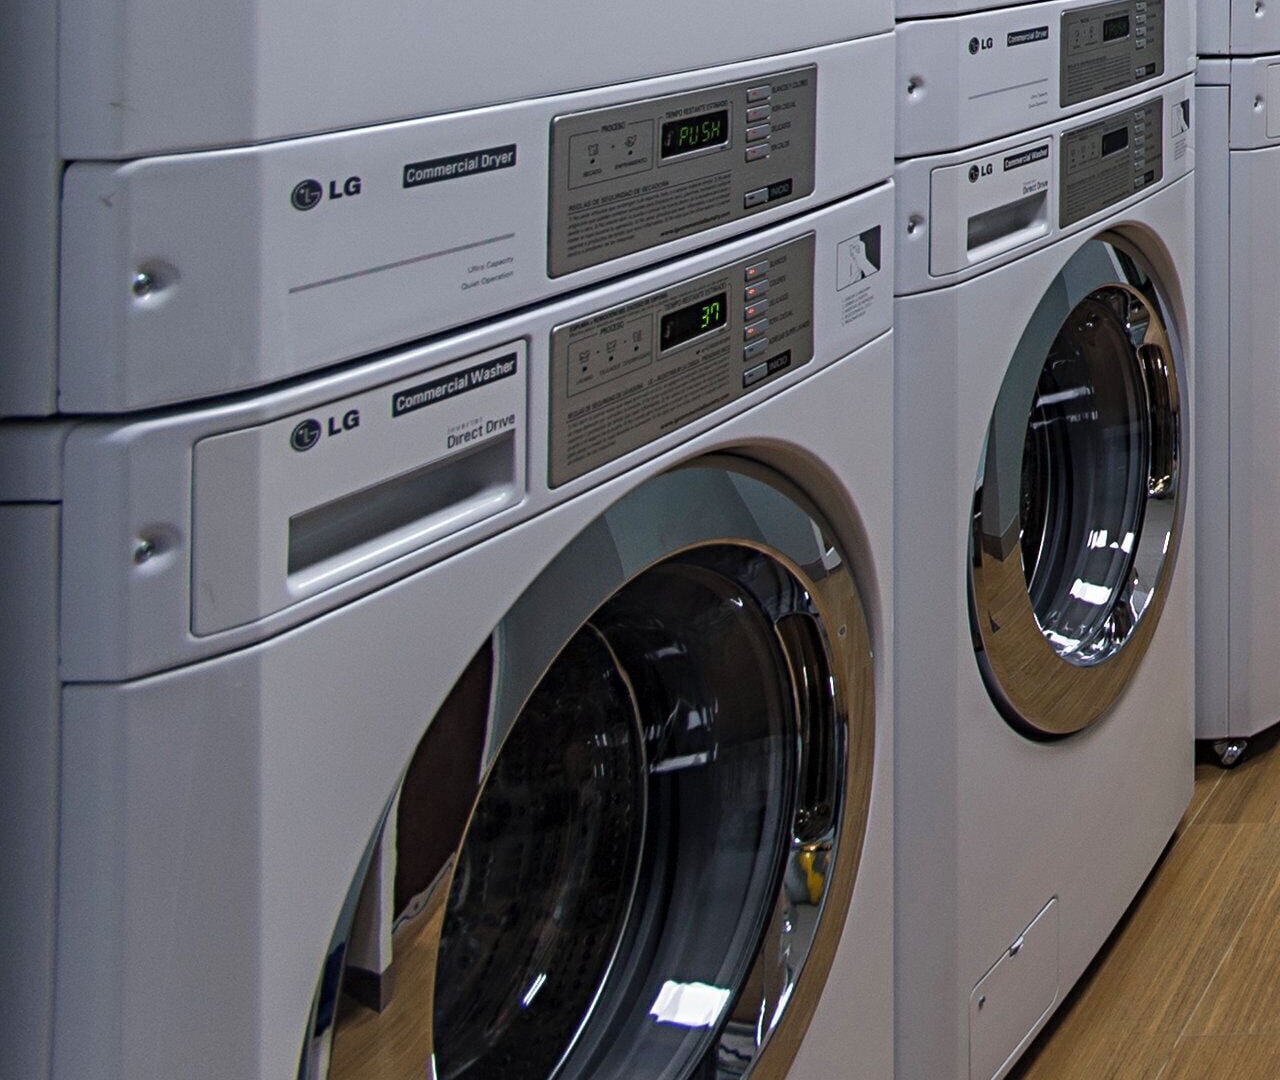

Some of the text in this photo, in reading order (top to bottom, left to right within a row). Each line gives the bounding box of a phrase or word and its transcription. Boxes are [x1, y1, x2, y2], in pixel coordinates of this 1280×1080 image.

[981, 37, 993, 50] LG
[678, 118, 720, 148] PUSH
[406, 150, 513, 183] Commercial Dryer
[981, 163, 993, 176] LG
[329, 176, 361, 200] LG
[700, 300, 719, 328] 37
[396, 359, 515, 411] Commercial Washer
[328, 409, 360, 437] LG
[447, 414, 516, 449] Direct Drive
